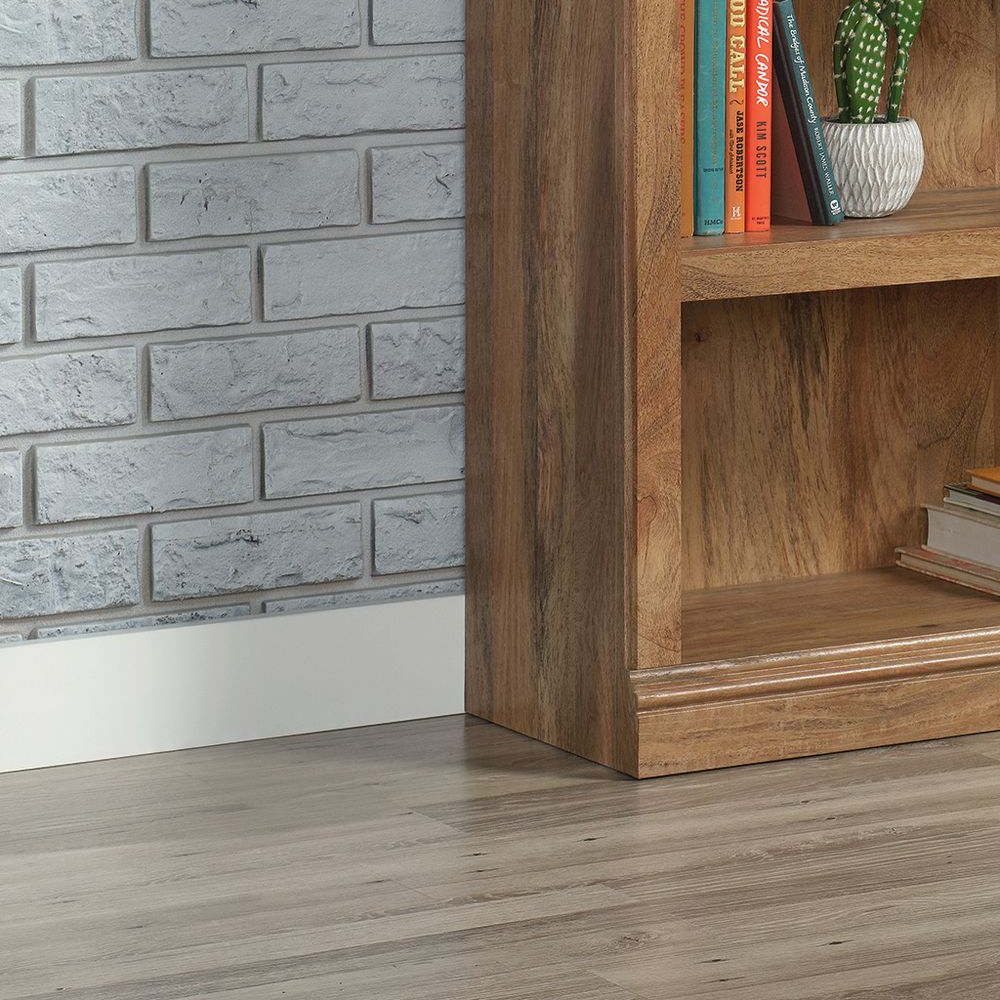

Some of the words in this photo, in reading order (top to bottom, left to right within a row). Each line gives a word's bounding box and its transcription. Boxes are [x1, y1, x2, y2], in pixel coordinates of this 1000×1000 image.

[786, 14, 794, 30] The
[789, 29, 801, 55] Bridges
[729, 34, 746, 93] CALL
[754, 53, 770, 107] CANDOR
[799, 65, 810, 96] Madison
[735, 110, 744, 134] JASE
[806, 96, 817, 125] County
[756, 121, 767, 140] KIM
[735, 136, 744, 192] ROBERTSON
[756, 146, 767, 179] SCOTT
